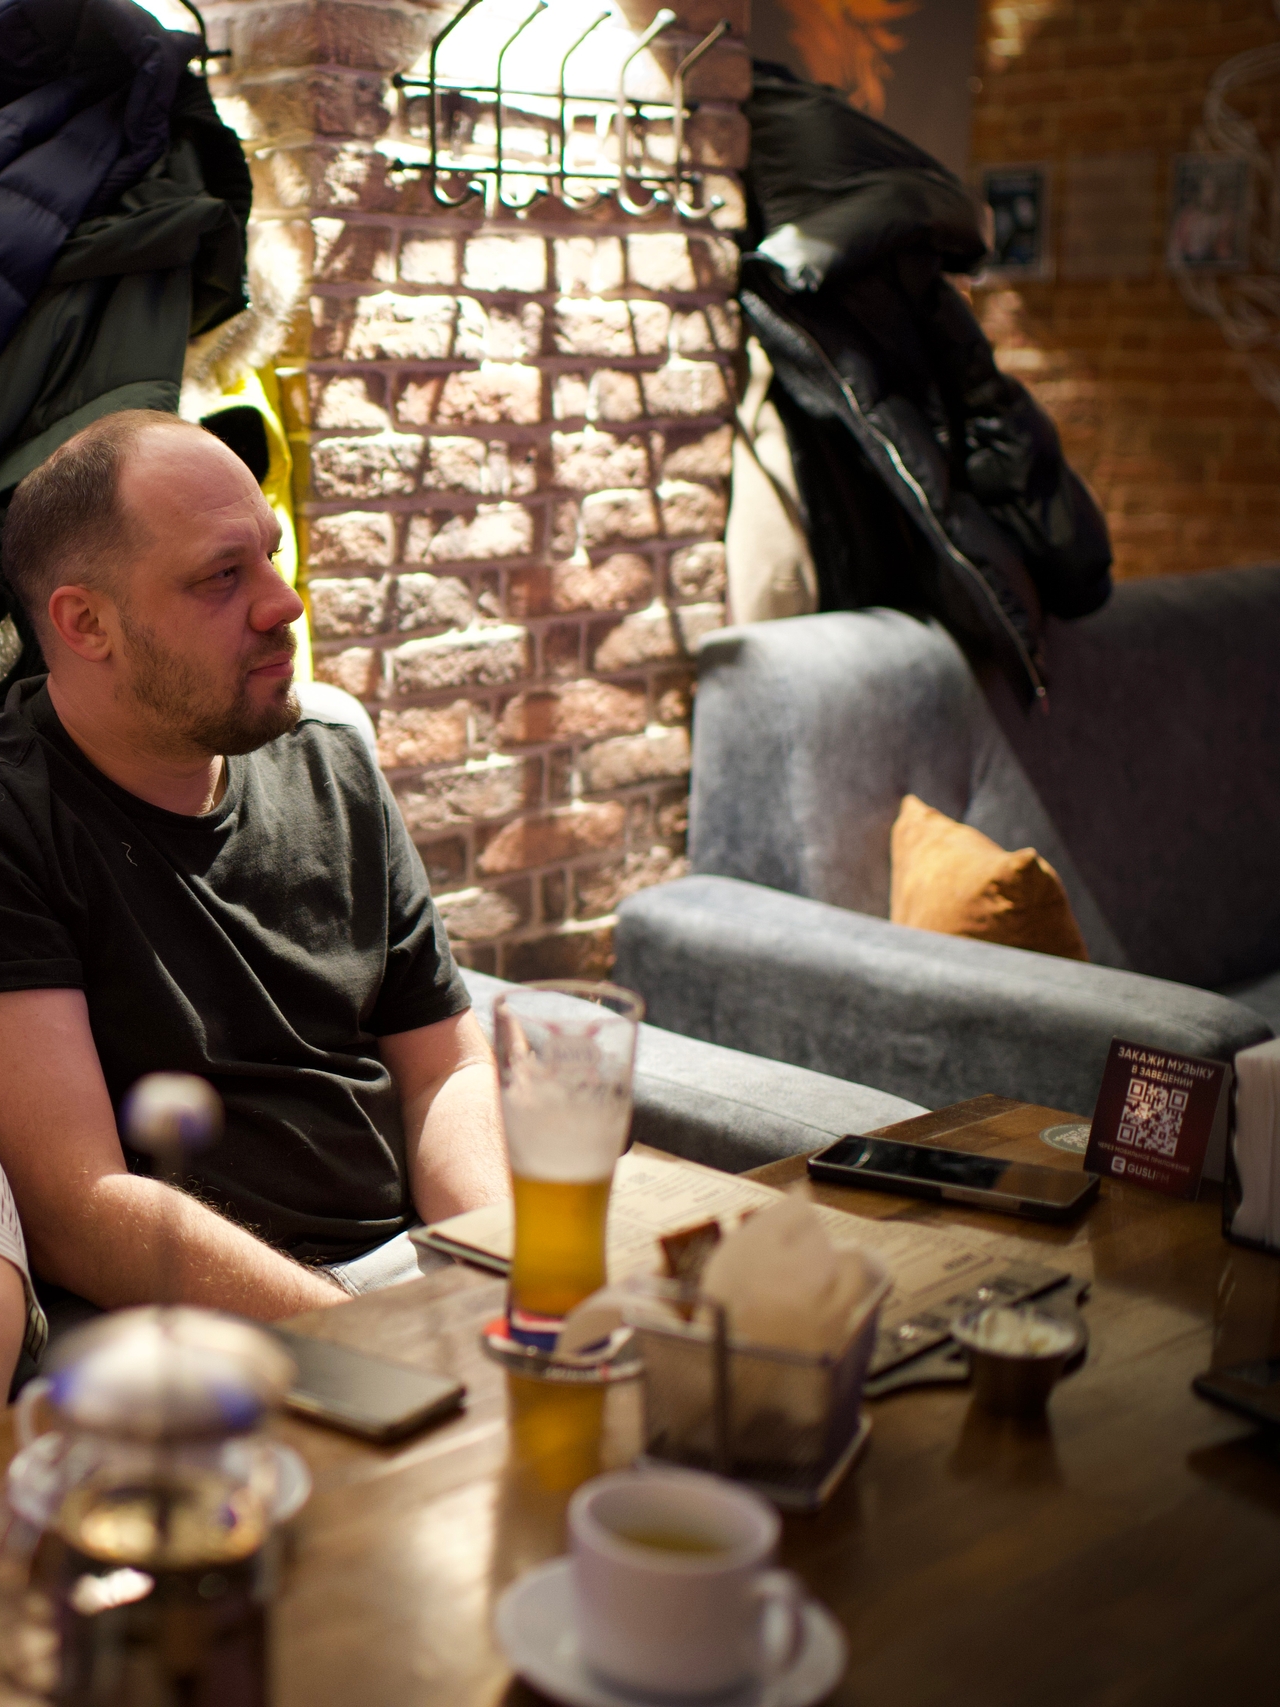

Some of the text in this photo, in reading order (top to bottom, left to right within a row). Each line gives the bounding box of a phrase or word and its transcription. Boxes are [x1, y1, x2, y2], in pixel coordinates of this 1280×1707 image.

[1118, 1047, 1214, 1079] ЗАКАЖИ МУЗЫКУ
[1131, 1065, 1194, 1088] В ЗАВЕДЕНИИ
[1097, 1141, 1114, 1151] ЧЕРЕЗ
[1114, 1145, 1150, 1161] МОБИЛЬНОЕ
